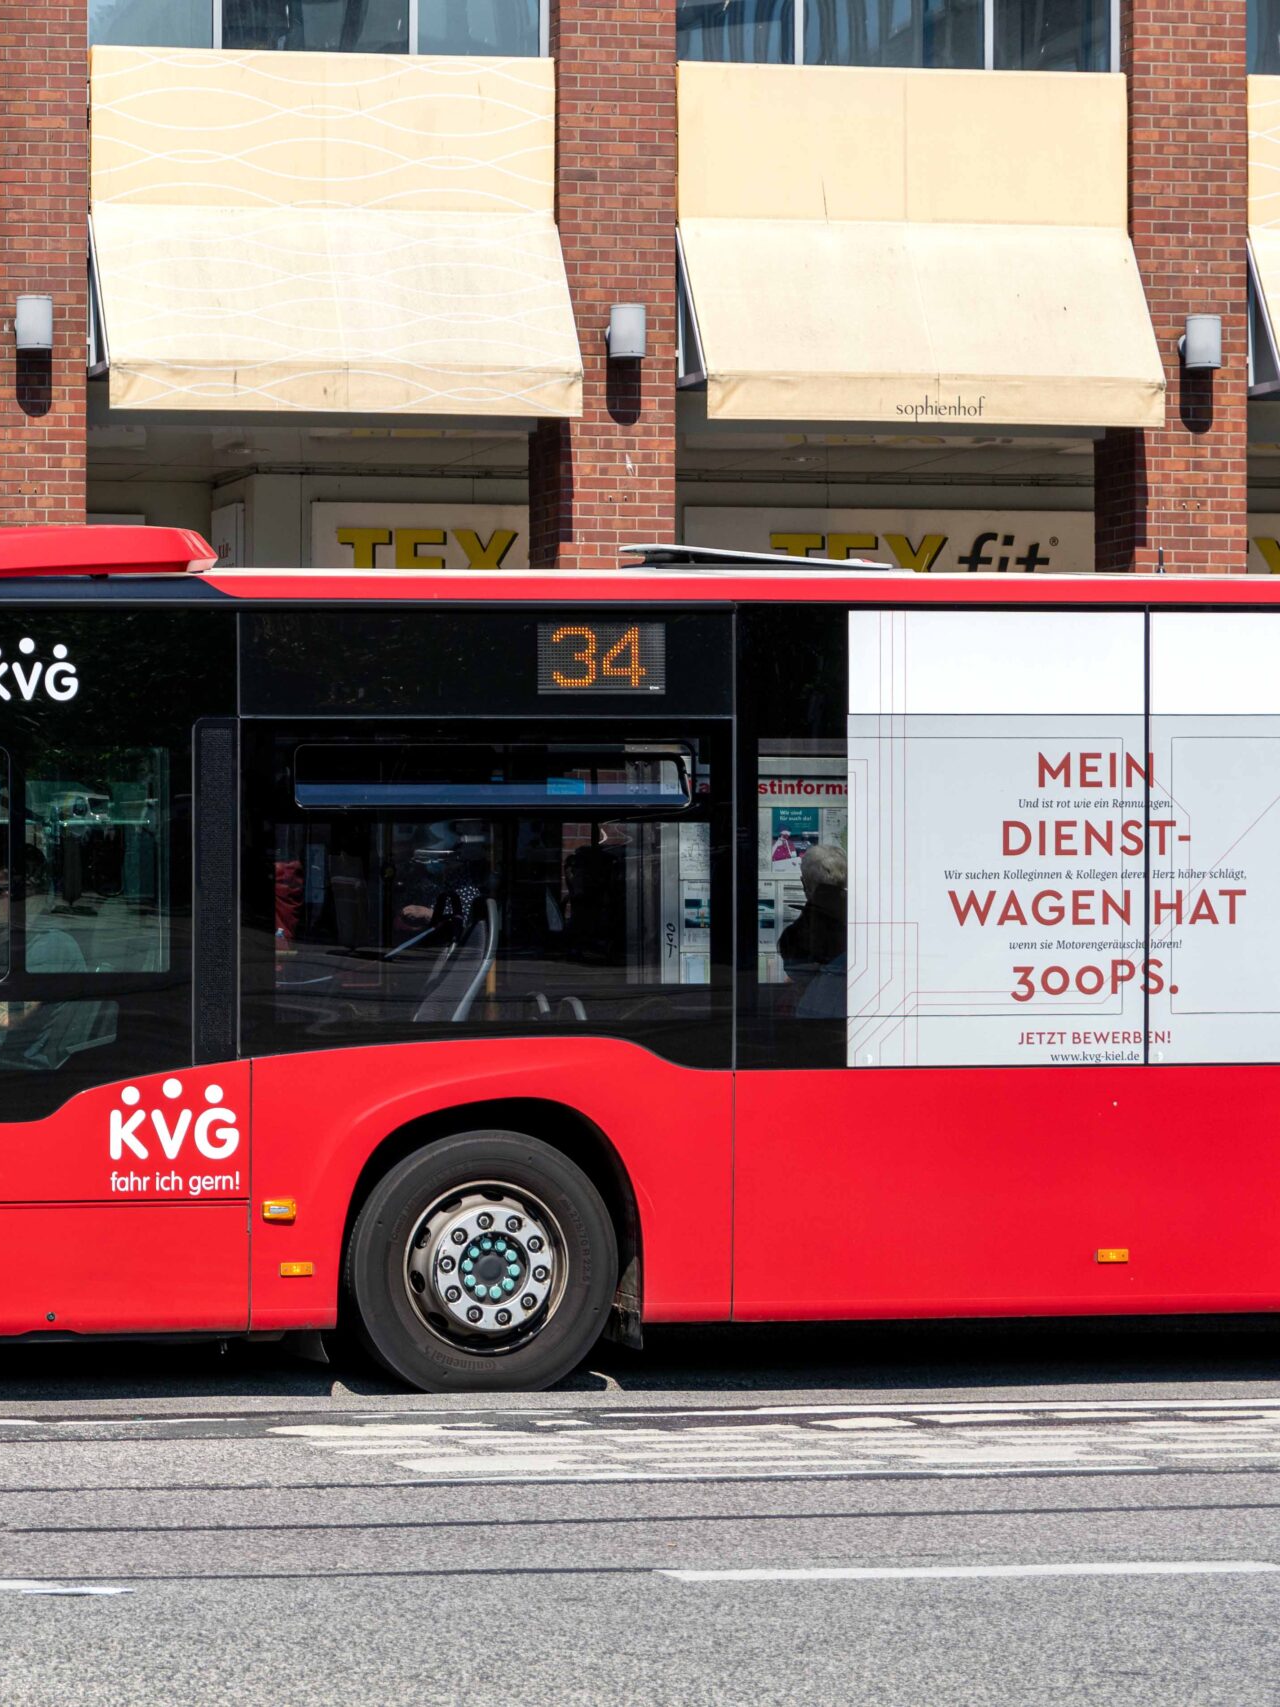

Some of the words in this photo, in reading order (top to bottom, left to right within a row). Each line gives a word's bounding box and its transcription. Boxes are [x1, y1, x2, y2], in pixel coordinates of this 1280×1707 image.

[895, 395, 986, 423] sophienhof
[551, 626, 647, 687] 34
[1037, 752, 1155, 788] MEIN
[1018, 798, 1040, 809] Und
[1041, 798, 1054, 809] ist
[1056, 799, 1071, 809] rot
[1073, 798, 1092, 809] wie
[1093, 798, 1109, 809] ein
[1002, 820, 1191, 856] DIENST-
[943, 869, 962, 880] Wir
[965, 869, 1000, 880] suchen
[1003, 869, 1062, 883] Kolleginnen
[1065, 870, 1073, 880] &
[1076, 869, 1118, 883] Kollegen
[1121, 868, 1147, 879] dere
[1152, 869, 1175, 879] Herz
[1178, 868, 1206, 880] höher
[1209, 868, 1247, 883] schlägt,
[948, 889, 1131, 926] WAGEN
[1154, 889, 1247, 926] HAT
[1008, 941, 1038, 950] wenn
[1040, 940, 1053, 950] sie
[1150, 938, 1183, 950] hören!
[1010, 958, 1179, 1002] 300PS.
[1018, 1032, 1067, 1045] JETZT
[1072, 1030, 1172, 1045] BEWERBEN!
[1050, 1051, 1140, 1064] www.kvg-kiel.de
[109, 1107, 240, 1160] KVG
[110, 1170, 150, 1192] fahr
[155, 1170, 183, 1192] ich
[188, 1170, 240, 1196] gern!
